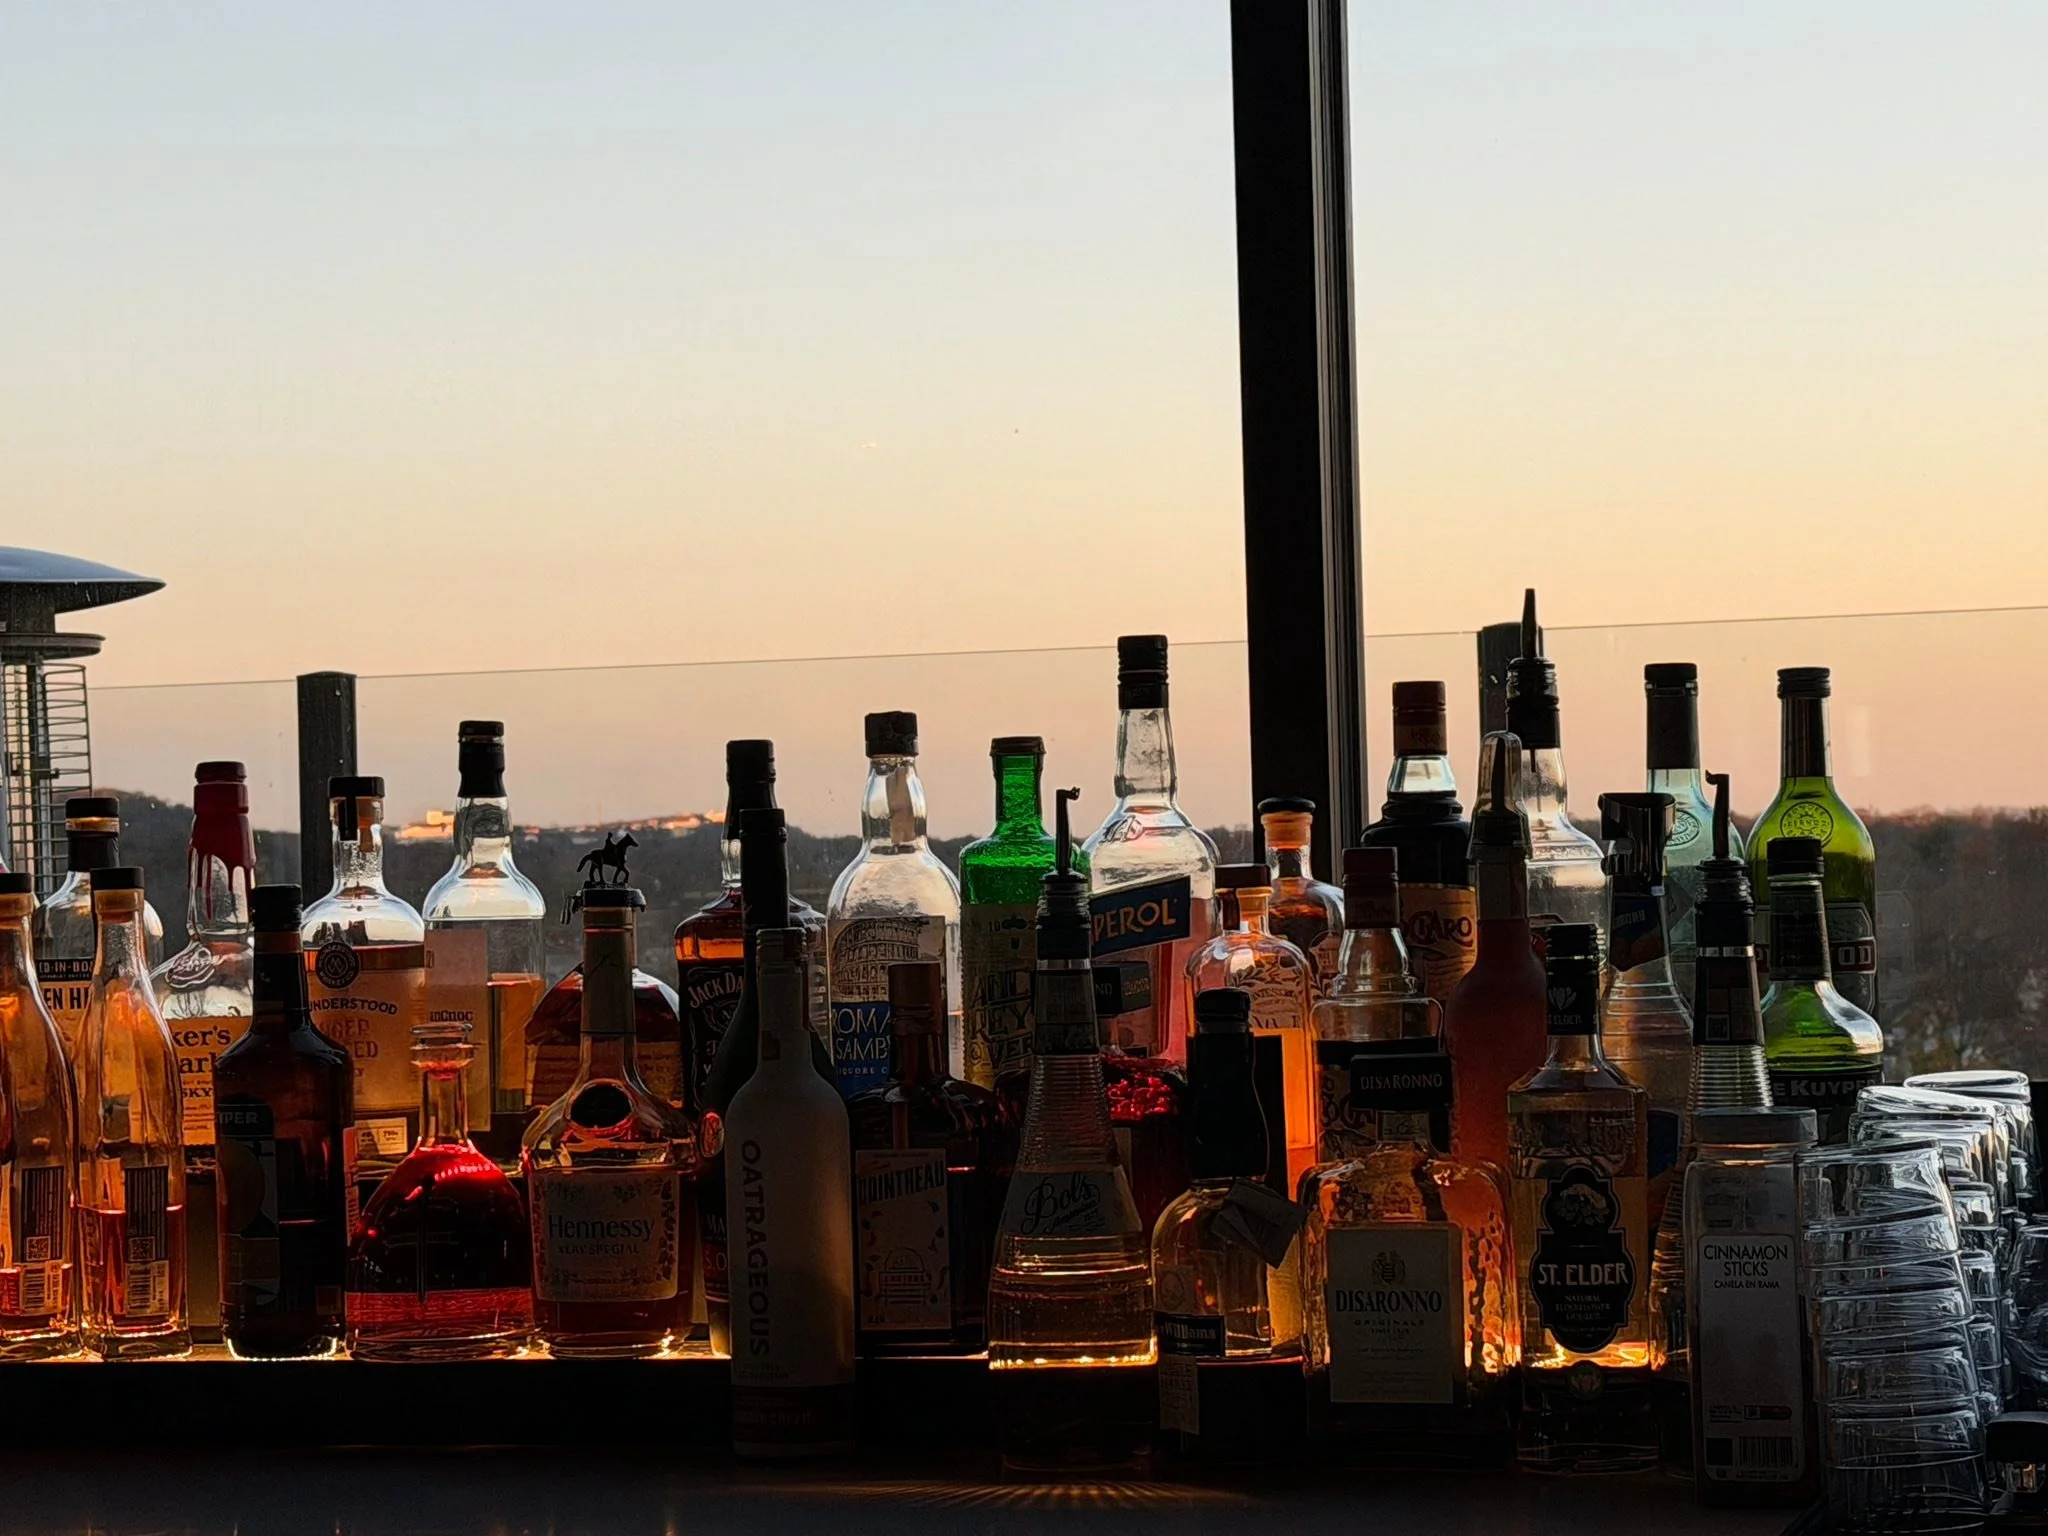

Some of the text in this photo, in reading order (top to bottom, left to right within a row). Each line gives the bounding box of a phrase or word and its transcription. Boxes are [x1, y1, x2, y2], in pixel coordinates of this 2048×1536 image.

[1093, 898, 1177, 945] PEROL
[688, 971, 745, 1008] JACK DA
[171, 1025, 232, 1047] ker's
[835, 1036, 891, 1061] SAMB
[839, 1066, 876, 1077] IQUORE
[1360, 1073, 1443, 1090] DISARONNO
[857, 1160, 946, 1206] COINTREAU
[1020, 1172, 1101, 1235] Bols
[548, 1213, 656, 1243] Hennessy
[589, 1243, 640, 1256] SPECIAL
[741, 1139, 771, 1358] OATRAGEOUS
[1703, 1244, 1789, 1261] CINNAMON
[1537, 1262, 1630, 1287] ST. ELDER
[1723, 1261, 1769, 1278] STICKS
[1713, 1279, 1781, 1290] CANELA EN RAMA
[1335, 1289, 1443, 1314] DISARONNO
[1163, 1321, 1217, 1340] Williams
[1353, 1318, 1426, 1328] ORIGINALE
